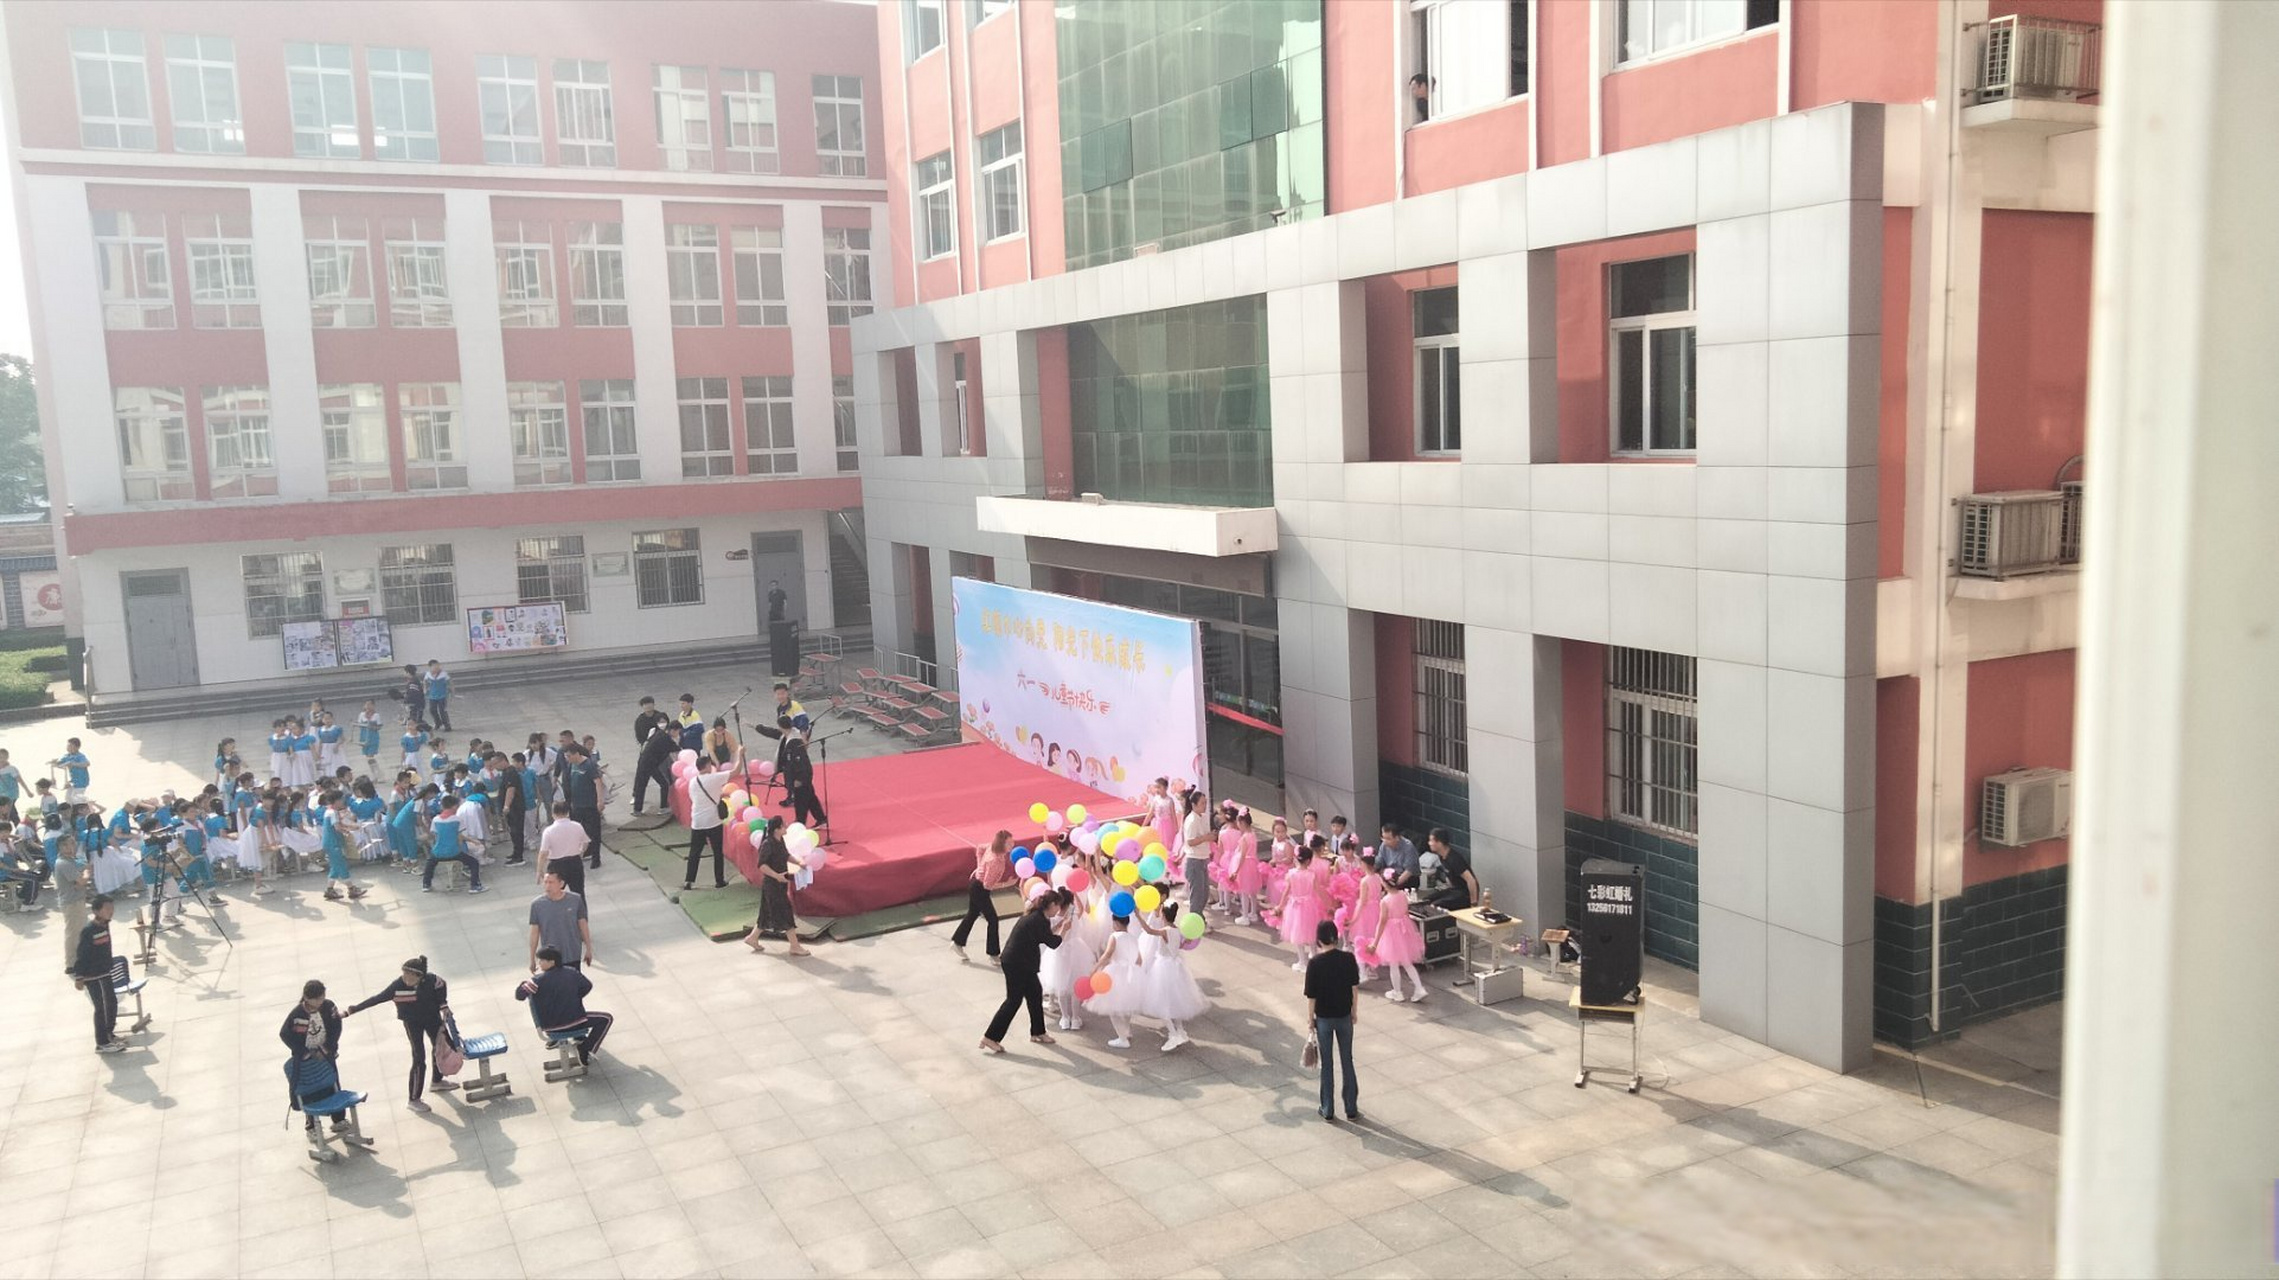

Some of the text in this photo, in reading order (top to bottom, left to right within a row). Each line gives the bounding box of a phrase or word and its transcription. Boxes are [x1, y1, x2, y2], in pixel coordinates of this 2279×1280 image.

[1017, 668, 1097, 712] 六一 儿童节快乐
[1587, 884, 1633, 901] 七彩虹婚礼
